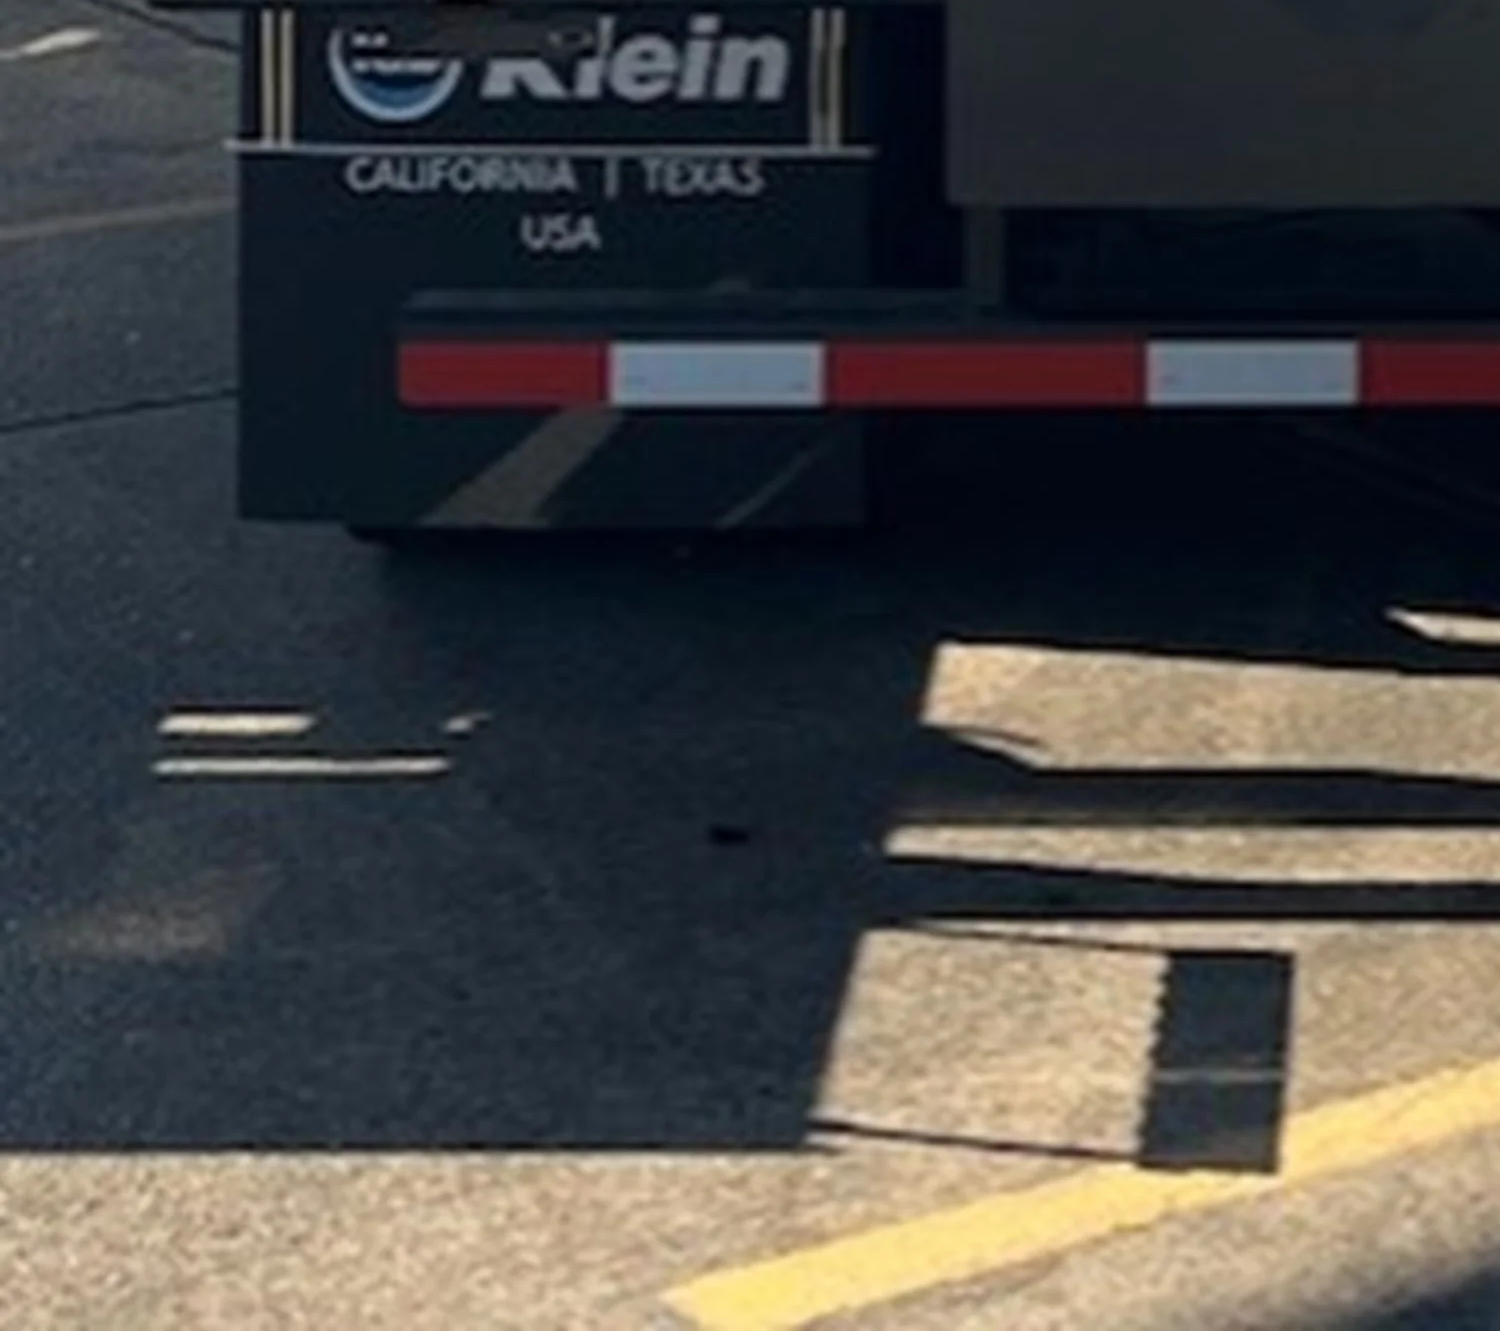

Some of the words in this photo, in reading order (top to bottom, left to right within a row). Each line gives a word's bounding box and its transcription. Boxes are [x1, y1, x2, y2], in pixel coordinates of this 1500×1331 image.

[344, 155, 579, 193] CALIFORNIA
[640, 156, 766, 195] TEXAS
[520, 213, 602, 251] USA
